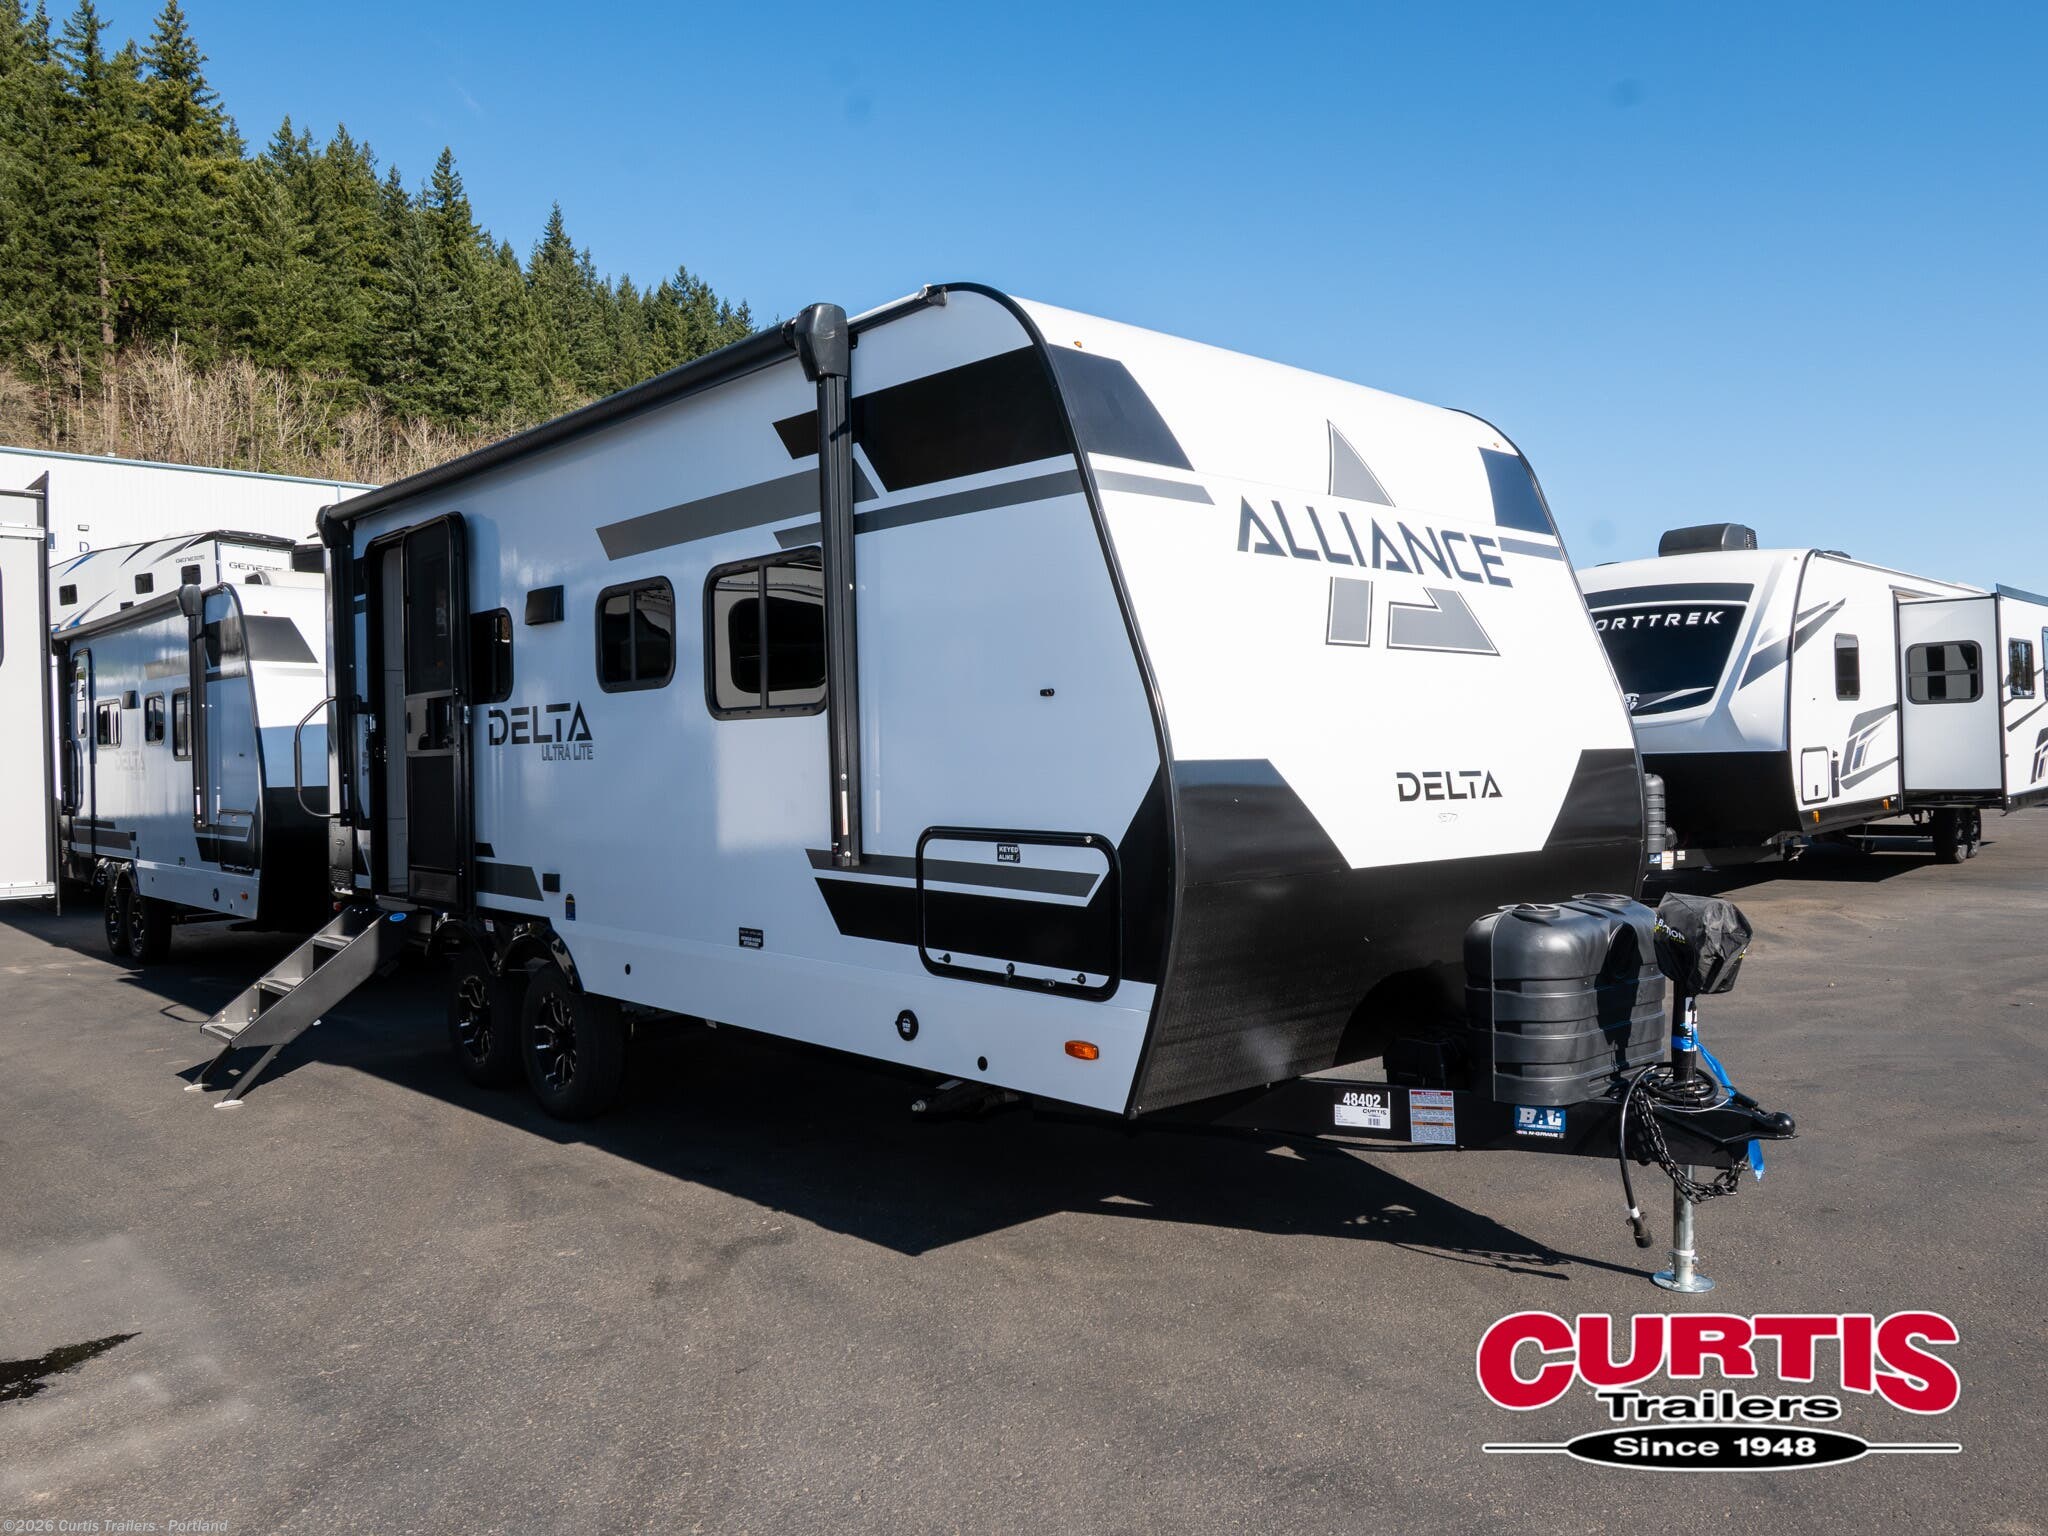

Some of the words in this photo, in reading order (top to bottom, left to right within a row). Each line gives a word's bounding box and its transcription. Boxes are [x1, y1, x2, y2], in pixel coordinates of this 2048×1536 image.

[1237, 495, 1513, 588] ALLIANCE
[488, 700, 593, 746] DELTA
[541, 744, 572, 761] ULTRA
[573, 743, 594, 761] LITE
[1396, 769, 1503, 802] DELTA
[1342, 1092, 1381, 1108] 48402
